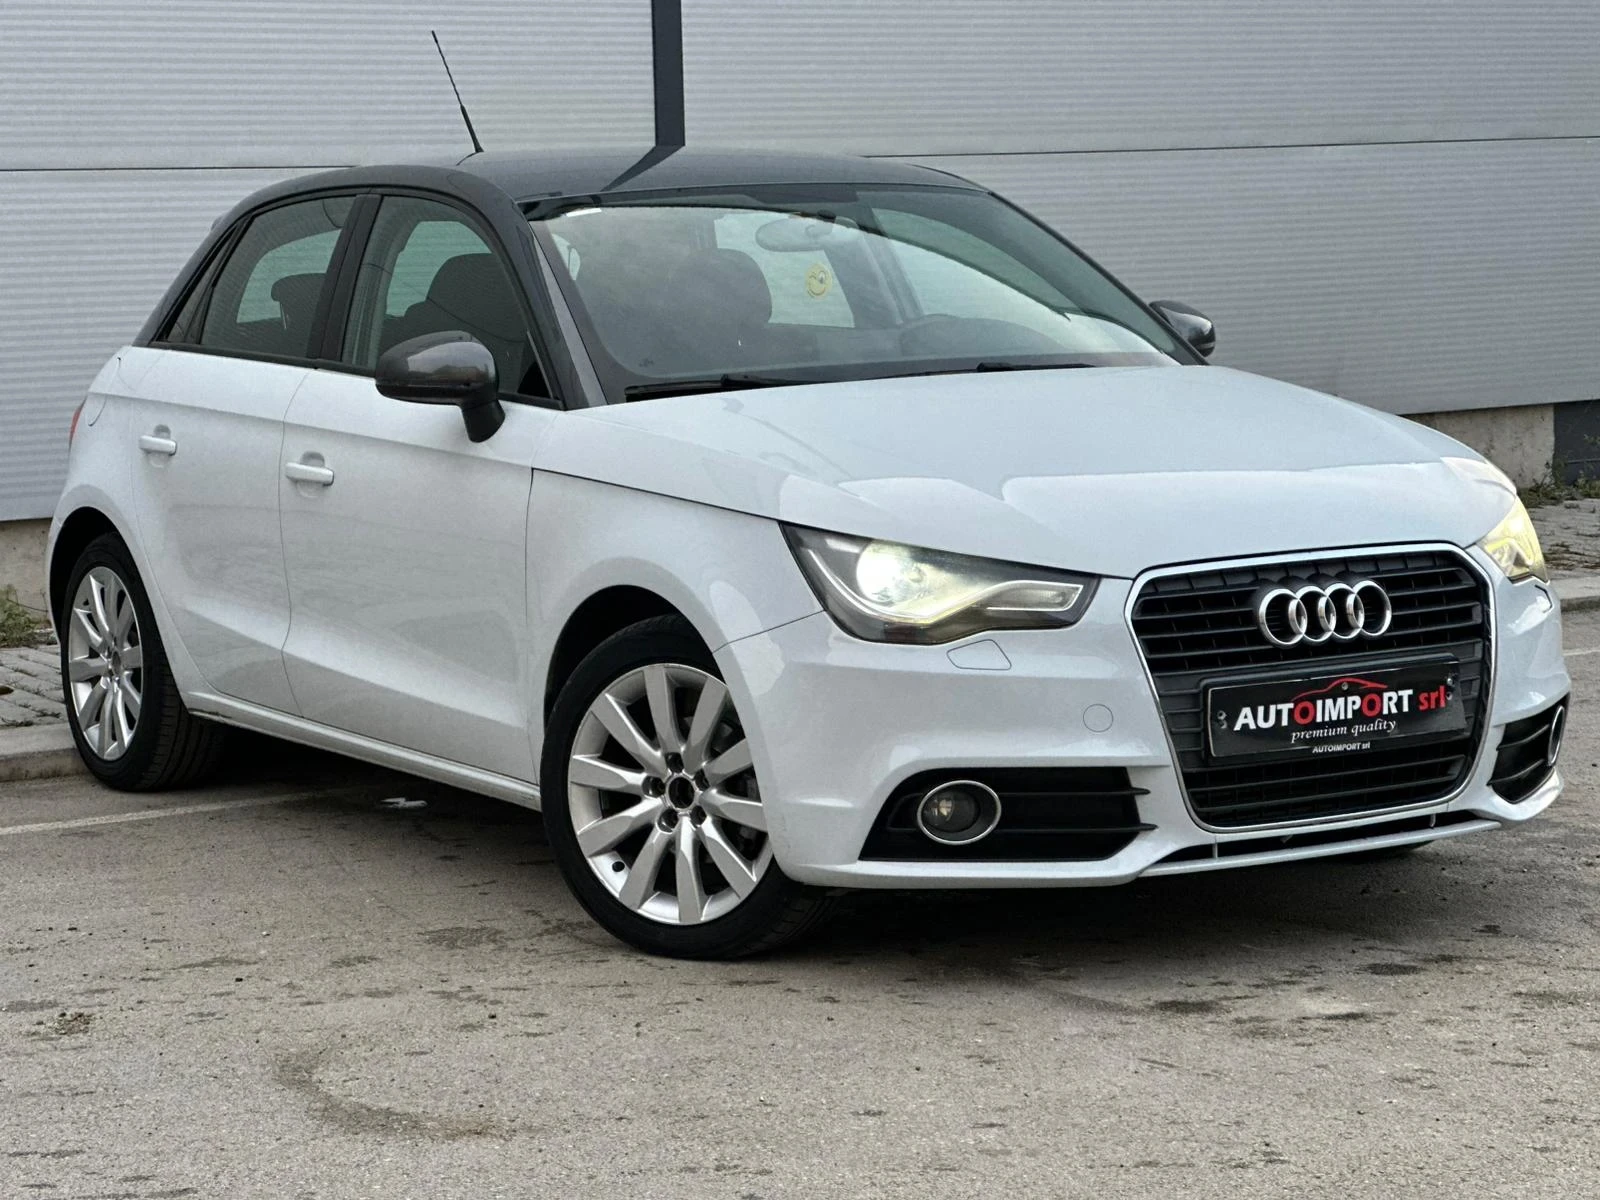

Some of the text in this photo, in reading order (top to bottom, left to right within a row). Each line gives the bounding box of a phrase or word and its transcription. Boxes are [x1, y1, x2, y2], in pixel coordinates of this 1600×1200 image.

[1233, 686, 1446, 731] AUTOIMPORT srl
[1290, 719, 1396, 744] premium quality
[1312, 742, 1361, 754] AUTOIMPORT
